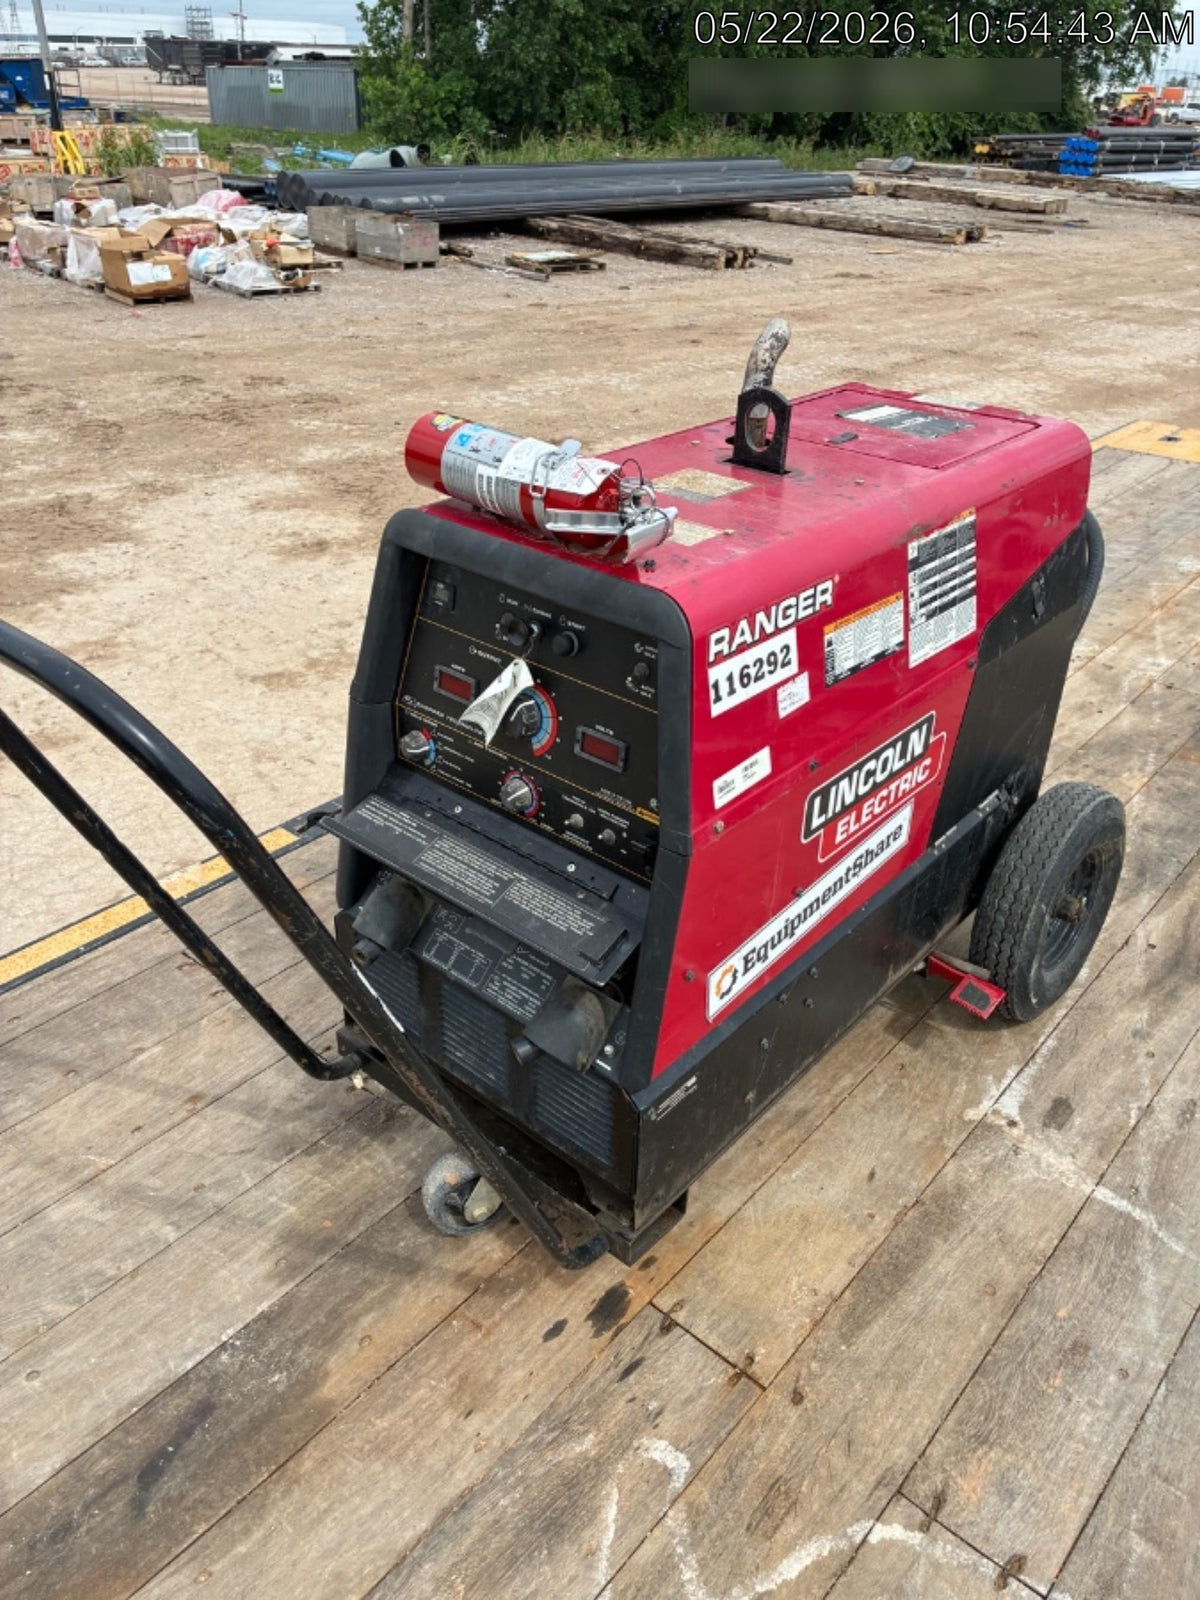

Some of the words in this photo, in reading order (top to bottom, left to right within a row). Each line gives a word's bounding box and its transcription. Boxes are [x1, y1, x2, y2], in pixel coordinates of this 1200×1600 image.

[708, 579, 833, 665] RANGER
[711, 643, 792, 705] 116292
[811, 723, 928, 830] LINCOLN
[835, 757, 932, 845] ELECTRIC
[741, 824, 903, 977] EquipmentShare
